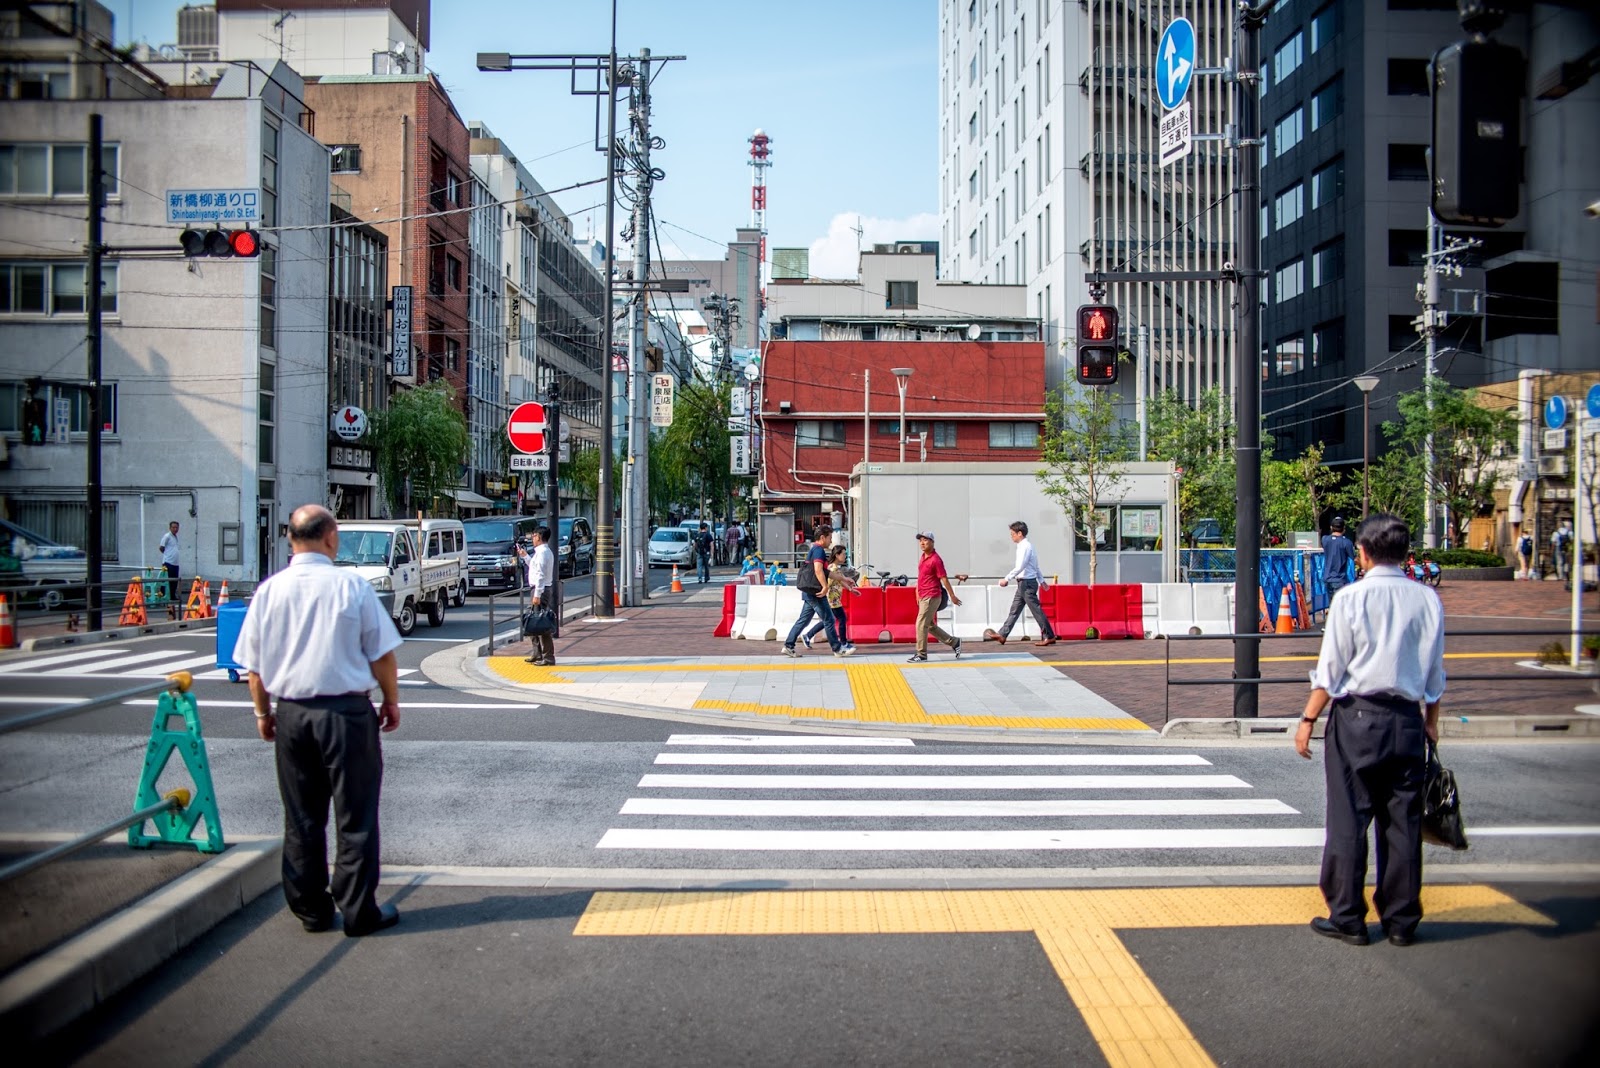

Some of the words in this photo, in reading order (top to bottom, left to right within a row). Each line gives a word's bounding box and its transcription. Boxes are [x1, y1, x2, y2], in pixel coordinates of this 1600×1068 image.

[1161, 110, 1188, 135] 自転車を除く
[1161, 124, 1188, 146] 一方通行
[170, 192, 256, 208] 新橋柳通り口
[172, 208, 236, 220] Shinbashiyanagi-dori
[395, 288, 408, 373] 信州おにかけ
[513, 458, 548, 467] 自転車を除く
